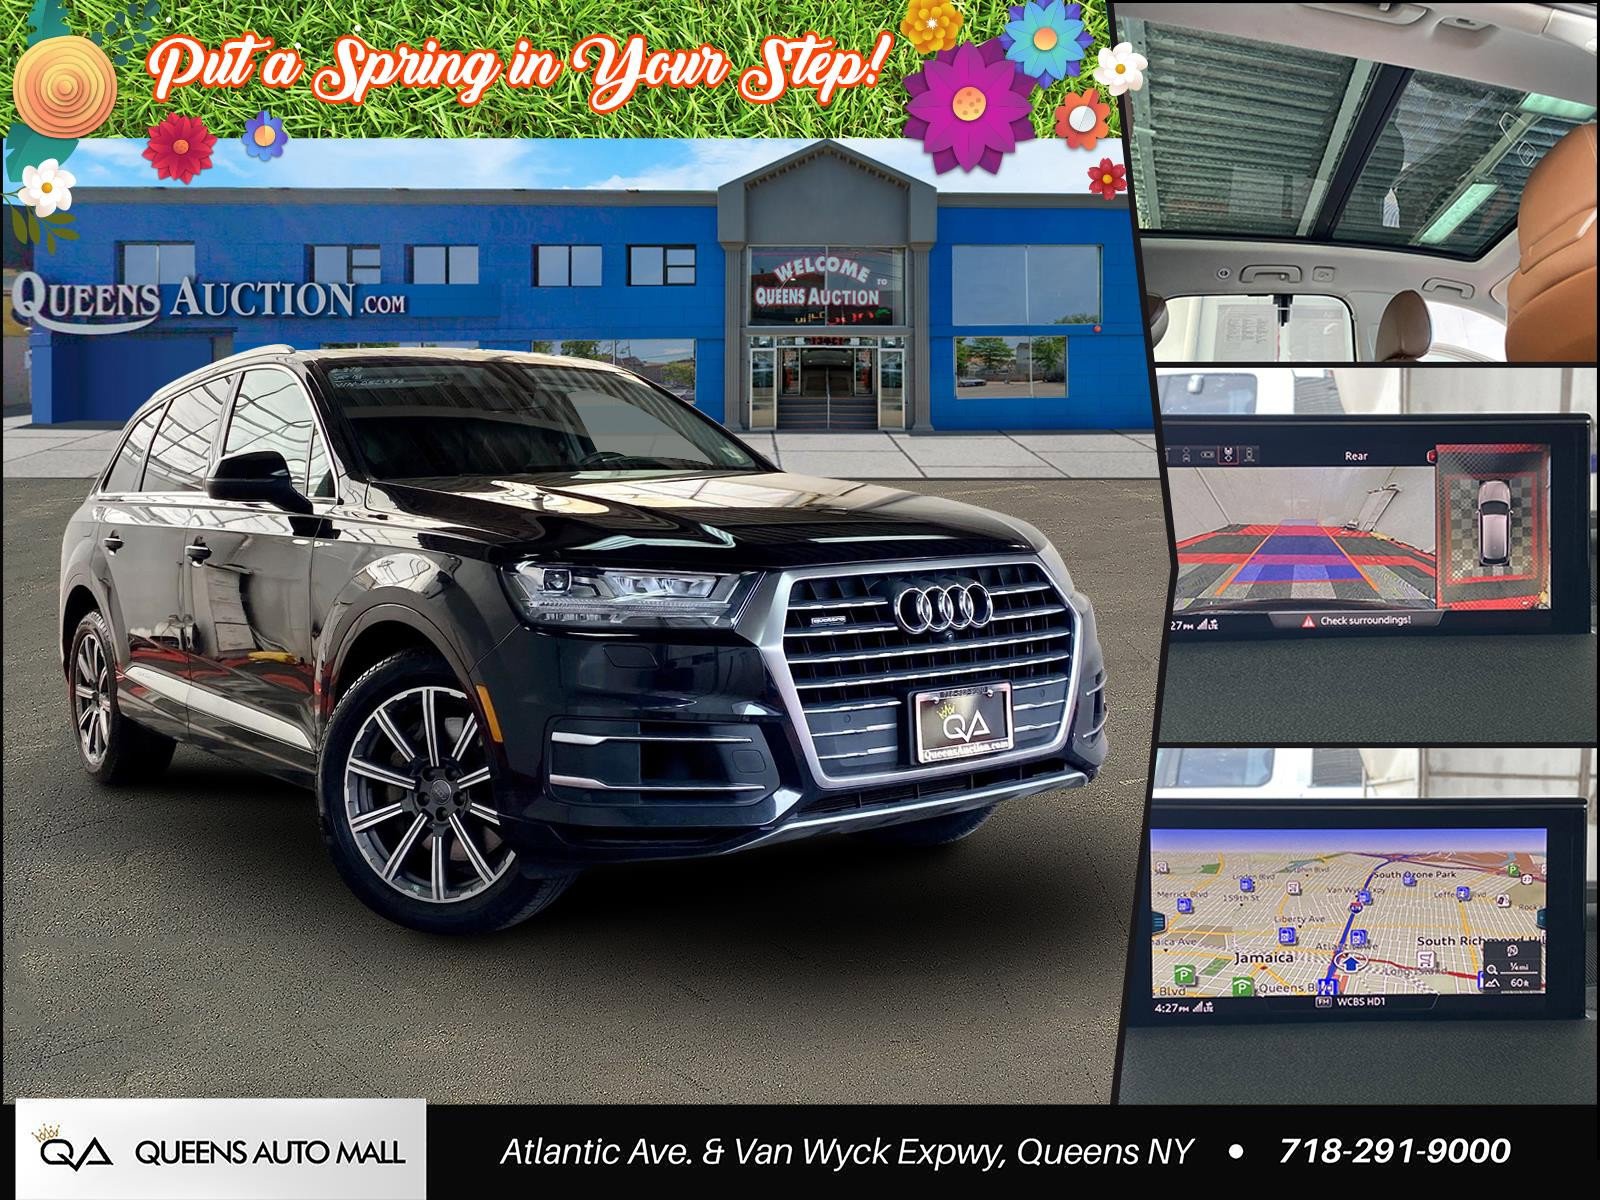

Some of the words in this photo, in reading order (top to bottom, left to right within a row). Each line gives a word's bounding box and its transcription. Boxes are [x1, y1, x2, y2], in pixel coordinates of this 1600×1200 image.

[774, 256, 871, 284] WELCOME
[877, 278, 888, 286] TO
[755, 287, 806, 306] QUEENS
[807, 287, 880, 306] AUCTION
[12, 271, 160, 334] QUEENS
[1345, 451, 1368, 461] Rear
[1321, 616, 1348, 625] Check
[1349, 616, 1411, 626] surroundings!
[943, 710, 991, 742] QA
[924, 741, 1009, 760] QueensAuction.com
[1223, 894, 1248, 902] 159th
[1274, 915, 1306, 923] Liberty
[1180, 938, 1197, 946] Ave
[1417, 936, 1455, 946] South
[1234, 952, 1294, 965] Jamaica
[1385, 967, 1411, 978] Long
[1160, 986, 1186, 996] Blvd
[1259, 983, 1303, 993] Queens
[1337, 998, 1365, 1006] WCBS
[1367, 998, 1385, 1006] HD1
